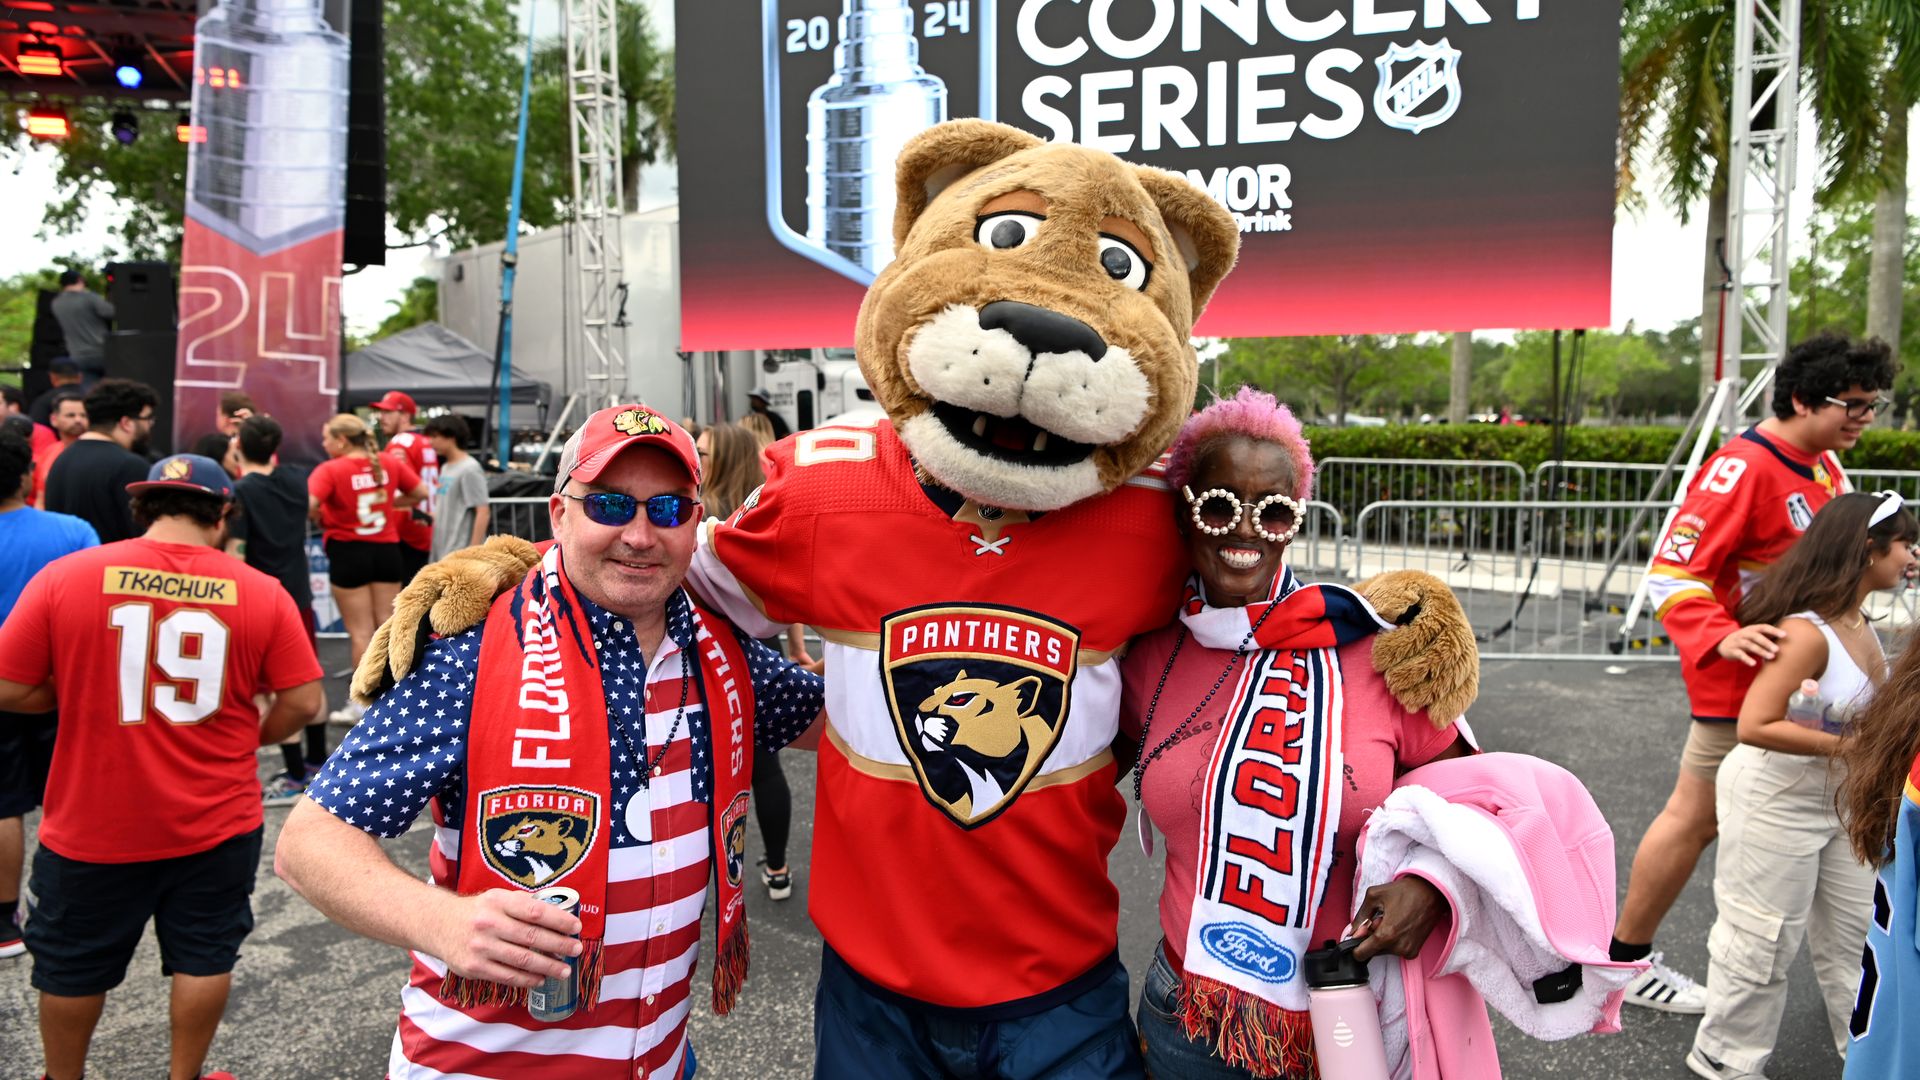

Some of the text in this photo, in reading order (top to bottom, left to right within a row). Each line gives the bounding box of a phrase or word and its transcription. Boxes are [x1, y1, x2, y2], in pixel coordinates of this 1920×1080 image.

[786, 0, 970, 53] 20 24
[1016, 0, 1540, 67] CONC
[1021, 47, 1364, 154] SERIES
[1393, 62, 1445, 116] NHL
[175, 265, 342, 395] 24
[1700, 456, 1748, 494] 19
[355, 491, 387, 535] 5
[118, 571, 226, 600] TKACHUK
[107, 600, 231, 727] 19
[902, 620, 1062, 665] PANTHERS
[490, 795, 586, 815] FLORIDA
[1215, 930, 1280, 974] Ford
